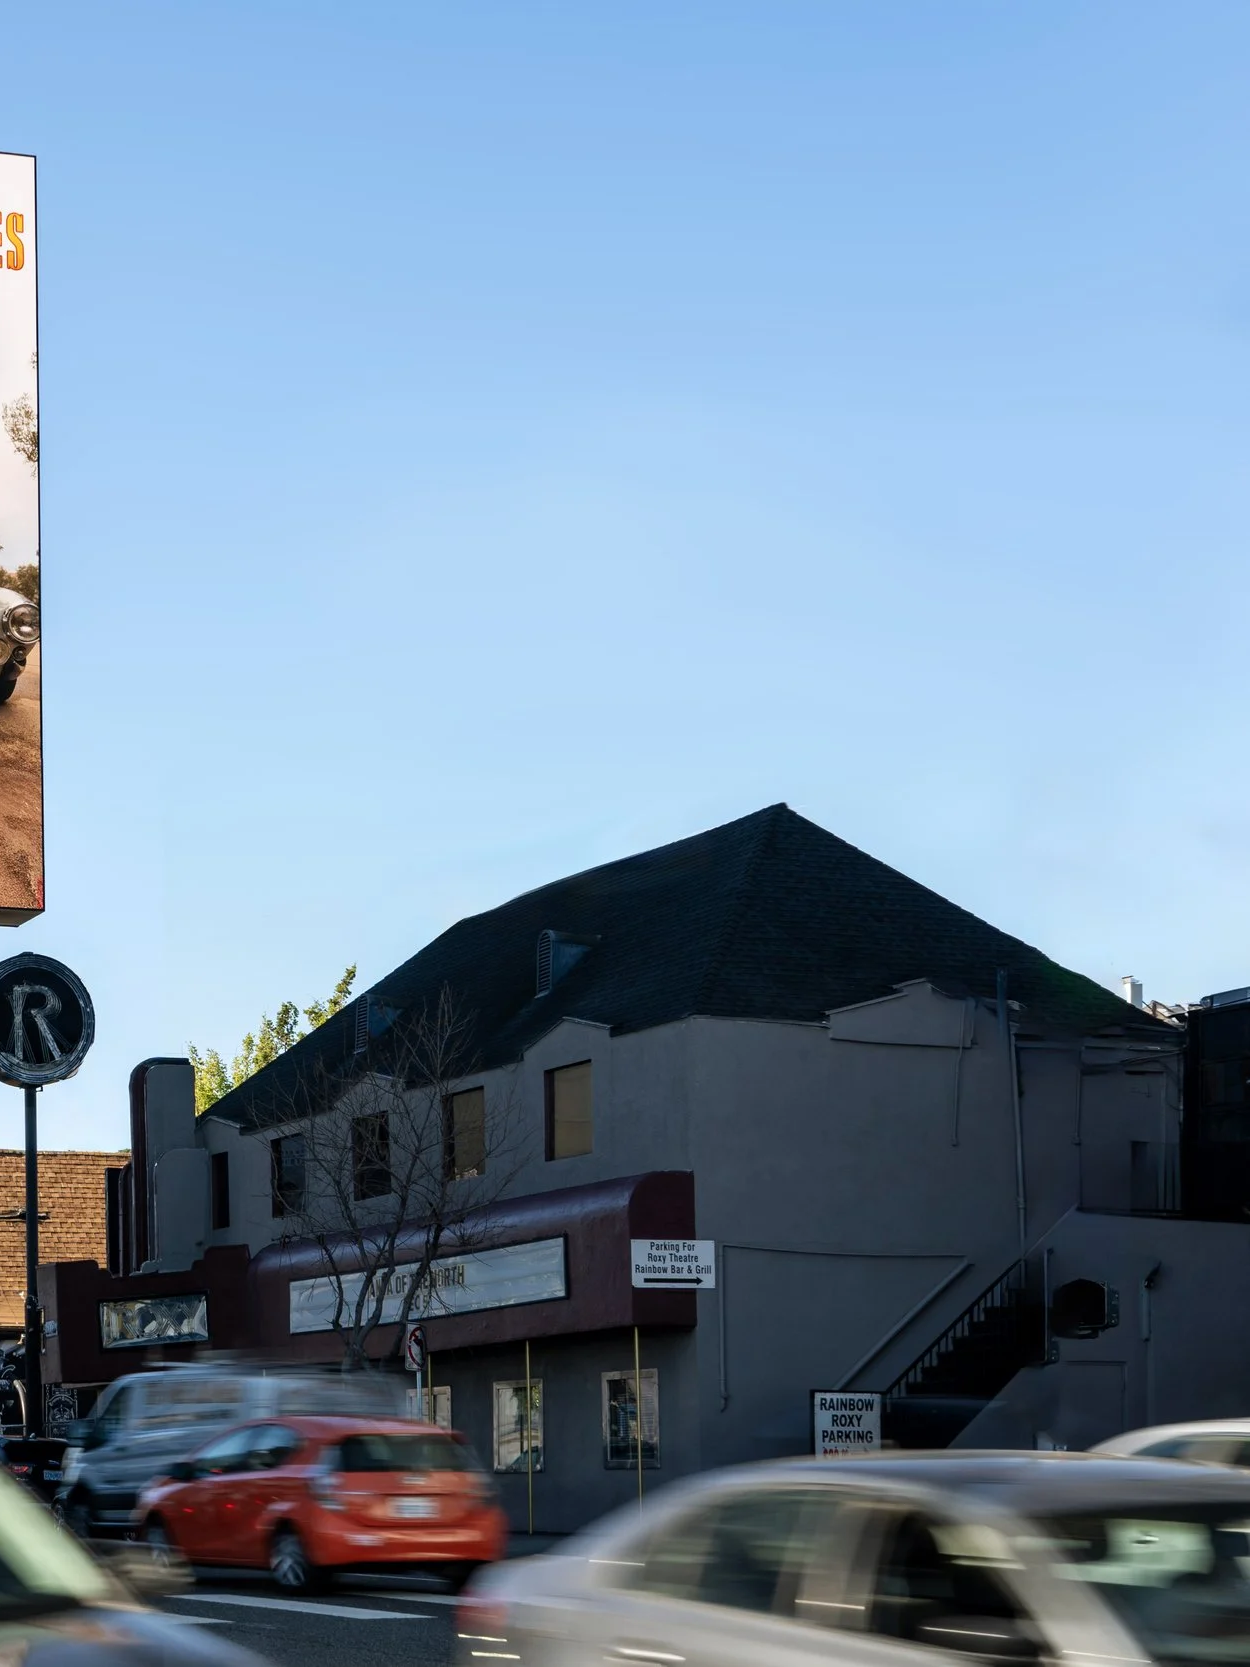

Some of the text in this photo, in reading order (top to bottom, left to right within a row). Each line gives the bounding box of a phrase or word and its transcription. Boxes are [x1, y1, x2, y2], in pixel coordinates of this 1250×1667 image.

[650, 1242, 695, 1253] Parking For
[647, 1253, 699, 1264] Roxy Theatre
[635, 1264, 712, 1275] Rainbow Bar & Grill
[395, 1274, 407, 1293] OF
[431, 1264, 465, 1289] NORTH
[819, 1397, 875, 1412] RAINBOW
[831, 1414, 863, 1428] ROXY
[821, 1430, 874, 1444] PARKING
